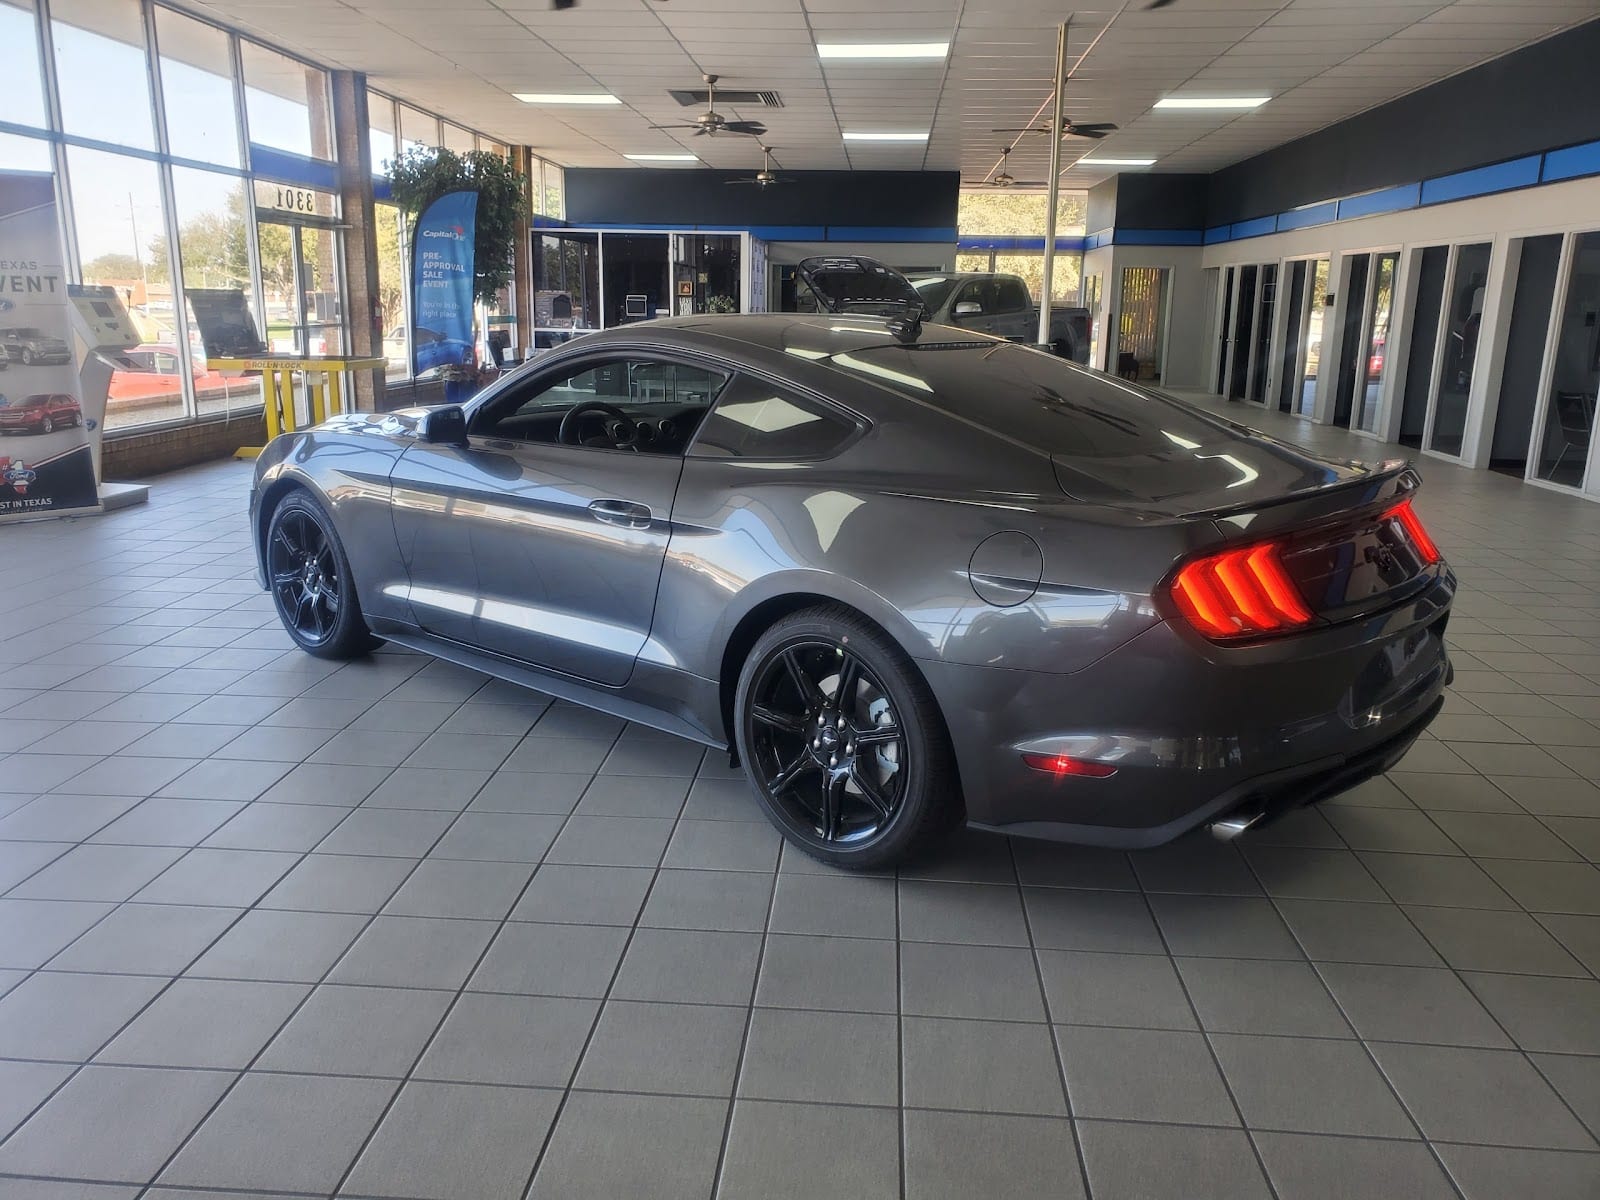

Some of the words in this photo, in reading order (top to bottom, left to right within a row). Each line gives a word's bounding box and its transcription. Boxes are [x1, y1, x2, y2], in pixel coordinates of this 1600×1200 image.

[423, 230, 465, 241] CapitalO
[0, 260, 37, 270] EXAS
[423, 261, 465, 273] APPROVAL
[423, 271, 443, 279] SALE
[423, 280, 448, 288] EVENT
[12, 500, 22, 508] IN
[24, 498, 52, 506] TEXAS
